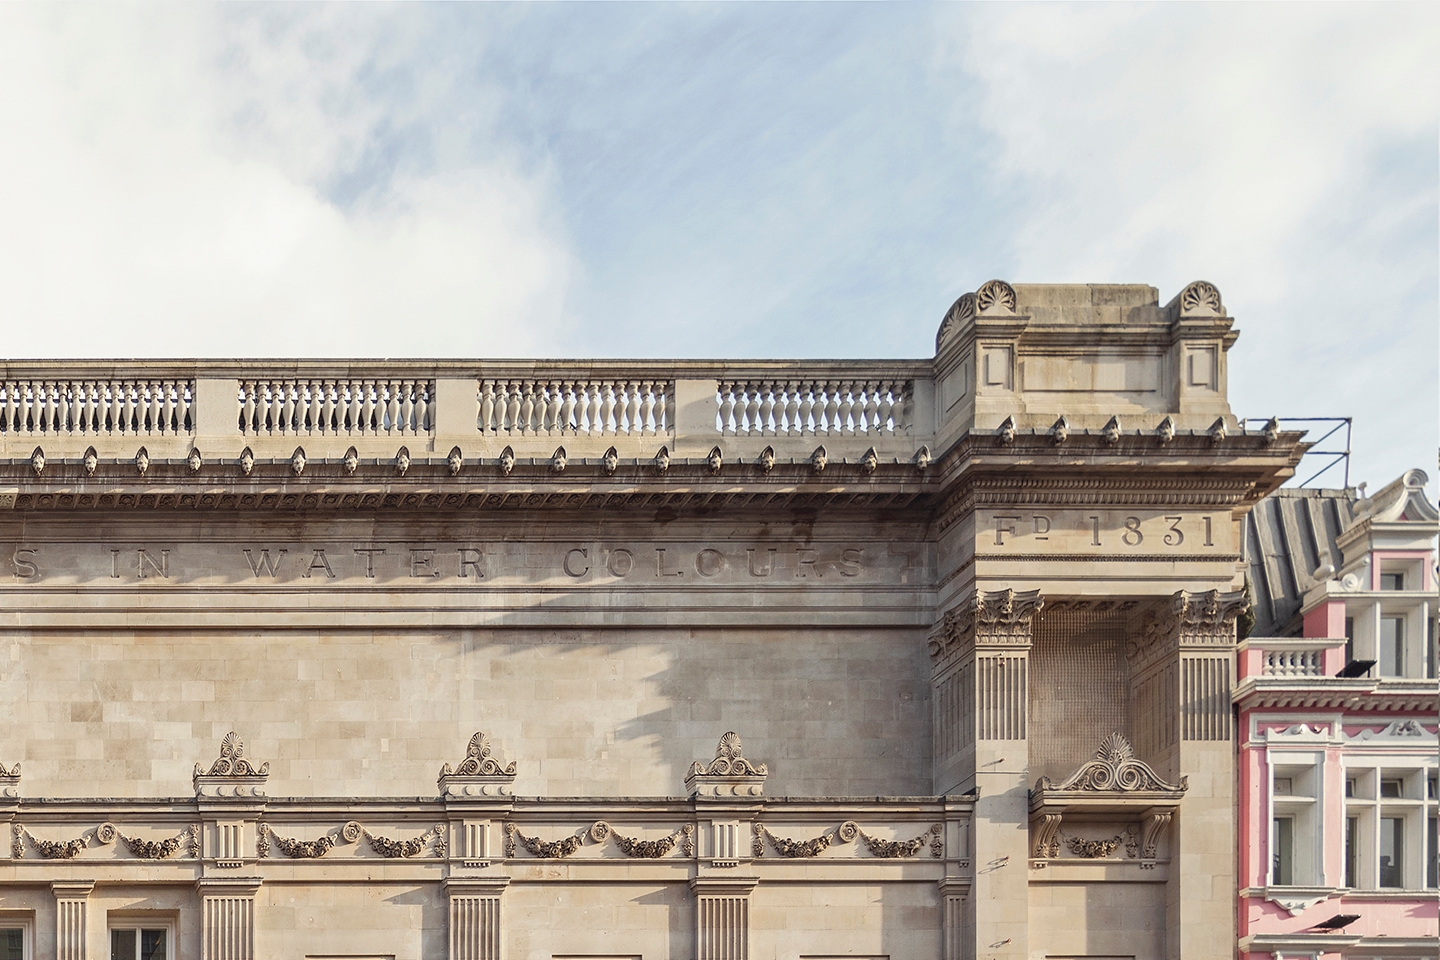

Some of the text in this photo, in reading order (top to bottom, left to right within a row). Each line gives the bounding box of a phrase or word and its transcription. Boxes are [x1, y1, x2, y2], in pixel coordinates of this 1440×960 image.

[1089, 515, 1215, 547] 1831
[110, 548, 172, 579] IN
[242, 547, 486, 580] WATER
[562, 547, 866, 580] COLOURS
